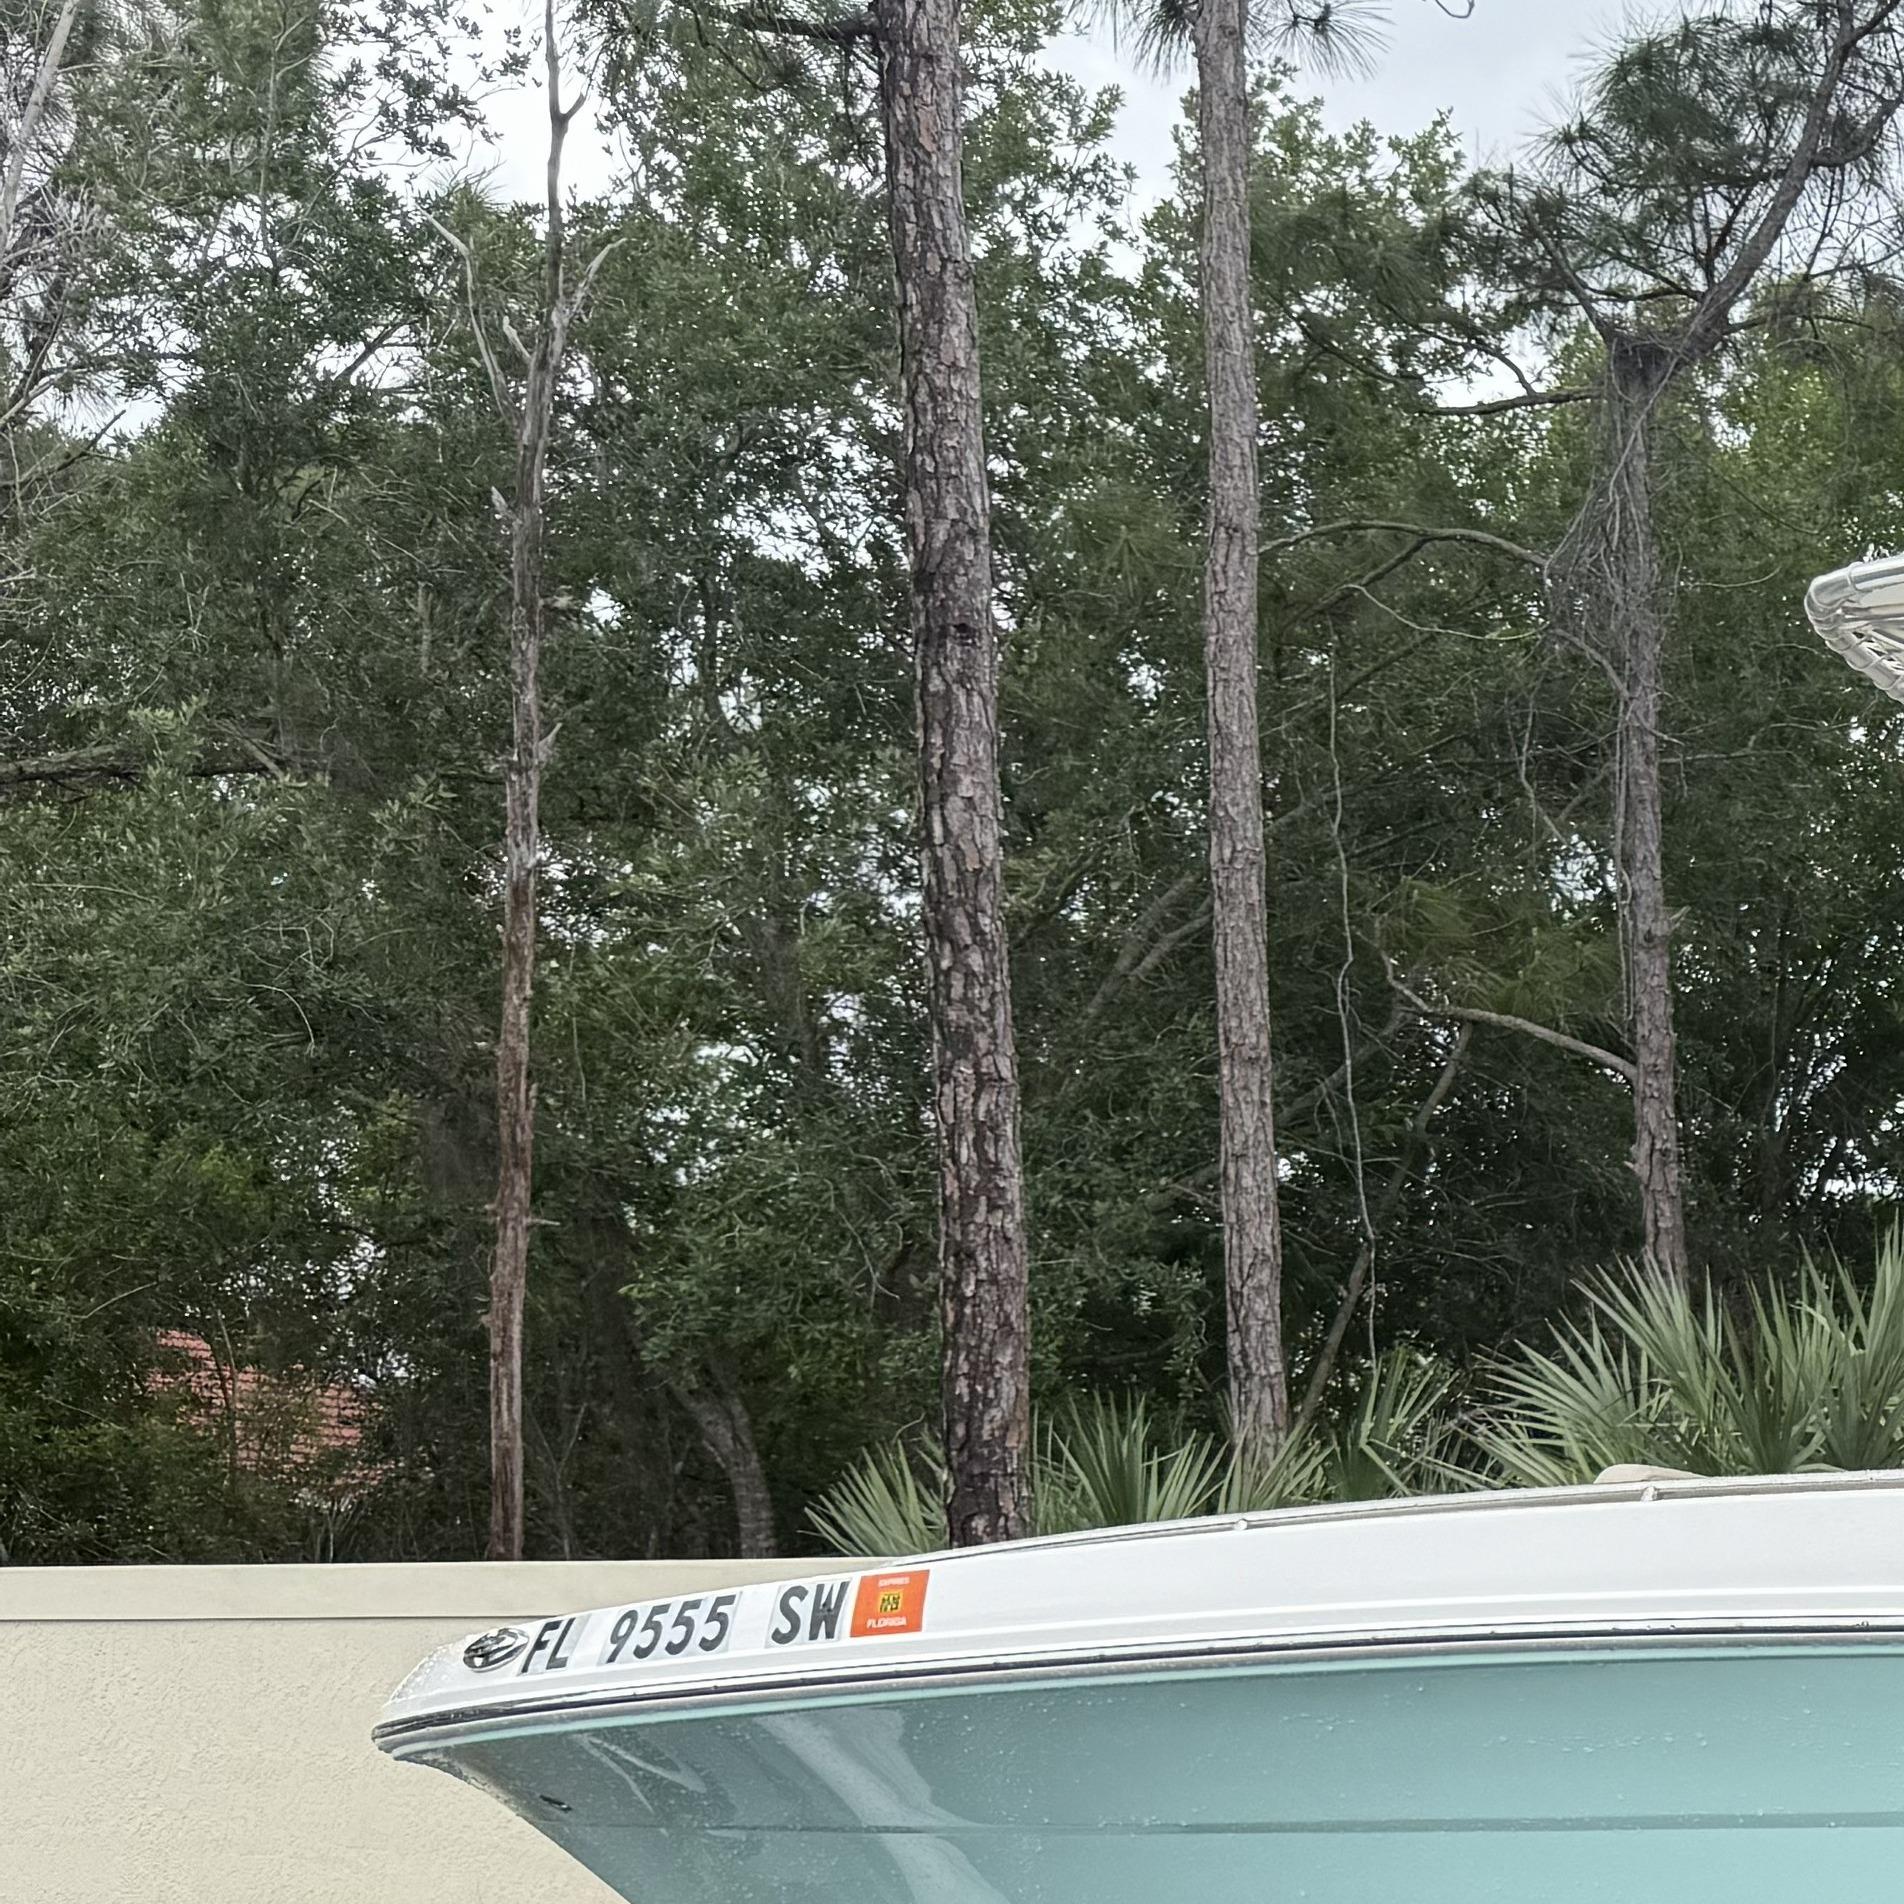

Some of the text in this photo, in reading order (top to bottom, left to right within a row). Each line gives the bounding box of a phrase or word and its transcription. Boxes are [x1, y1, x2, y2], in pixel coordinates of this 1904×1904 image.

[521, 1581, 849, 1673] FL 9555 SW
